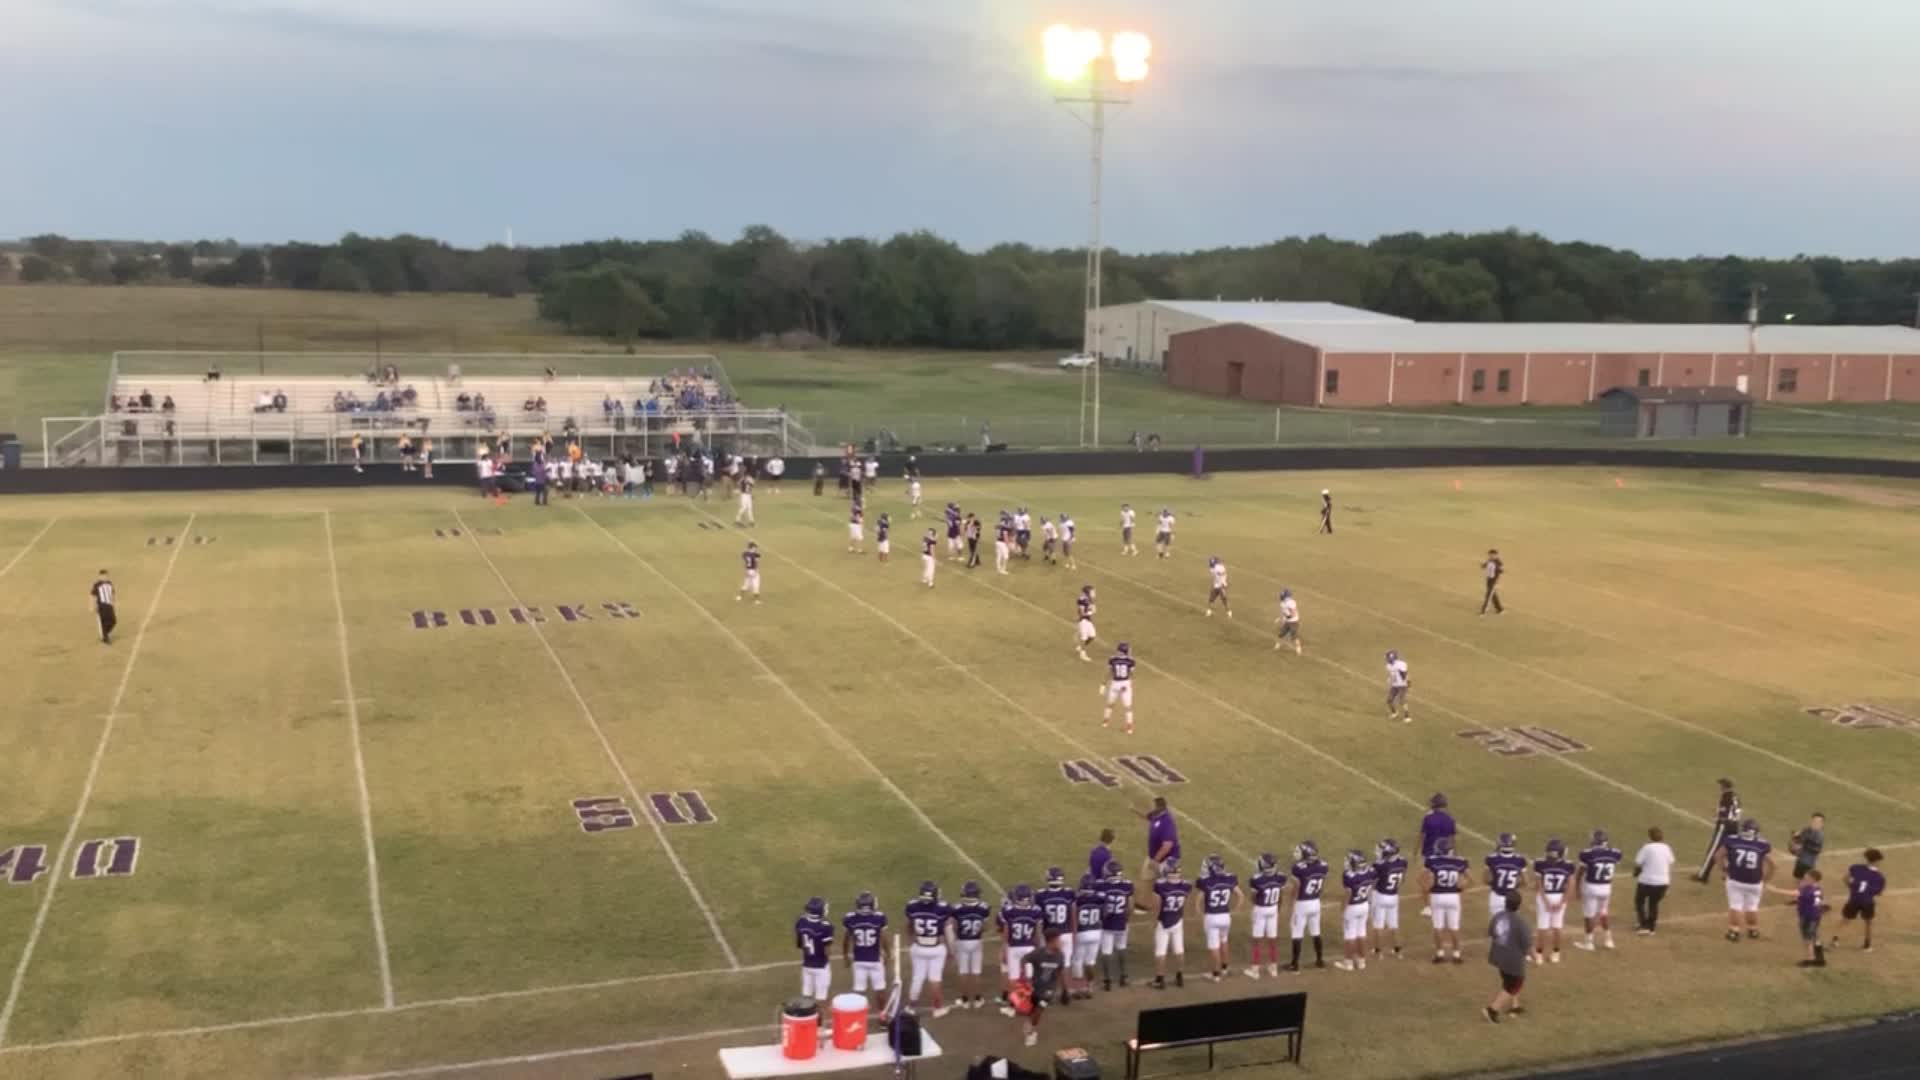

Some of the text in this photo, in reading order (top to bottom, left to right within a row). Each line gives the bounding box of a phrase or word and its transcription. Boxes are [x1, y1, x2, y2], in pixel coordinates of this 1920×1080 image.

[569, 790, 717, 833] 50
[1736, 849, 1757, 869] 79
[1438, 871, 1459, 887] 20
[1498, 870, 1518, 889] 75
[1594, 863, 1615, 881] 73
[1264, 888, 1280, 904] 10
[1045, 904, 1067, 923] 58
[1012, 923, 1033, 939] 34
[803, 934, 815, 955] 4
